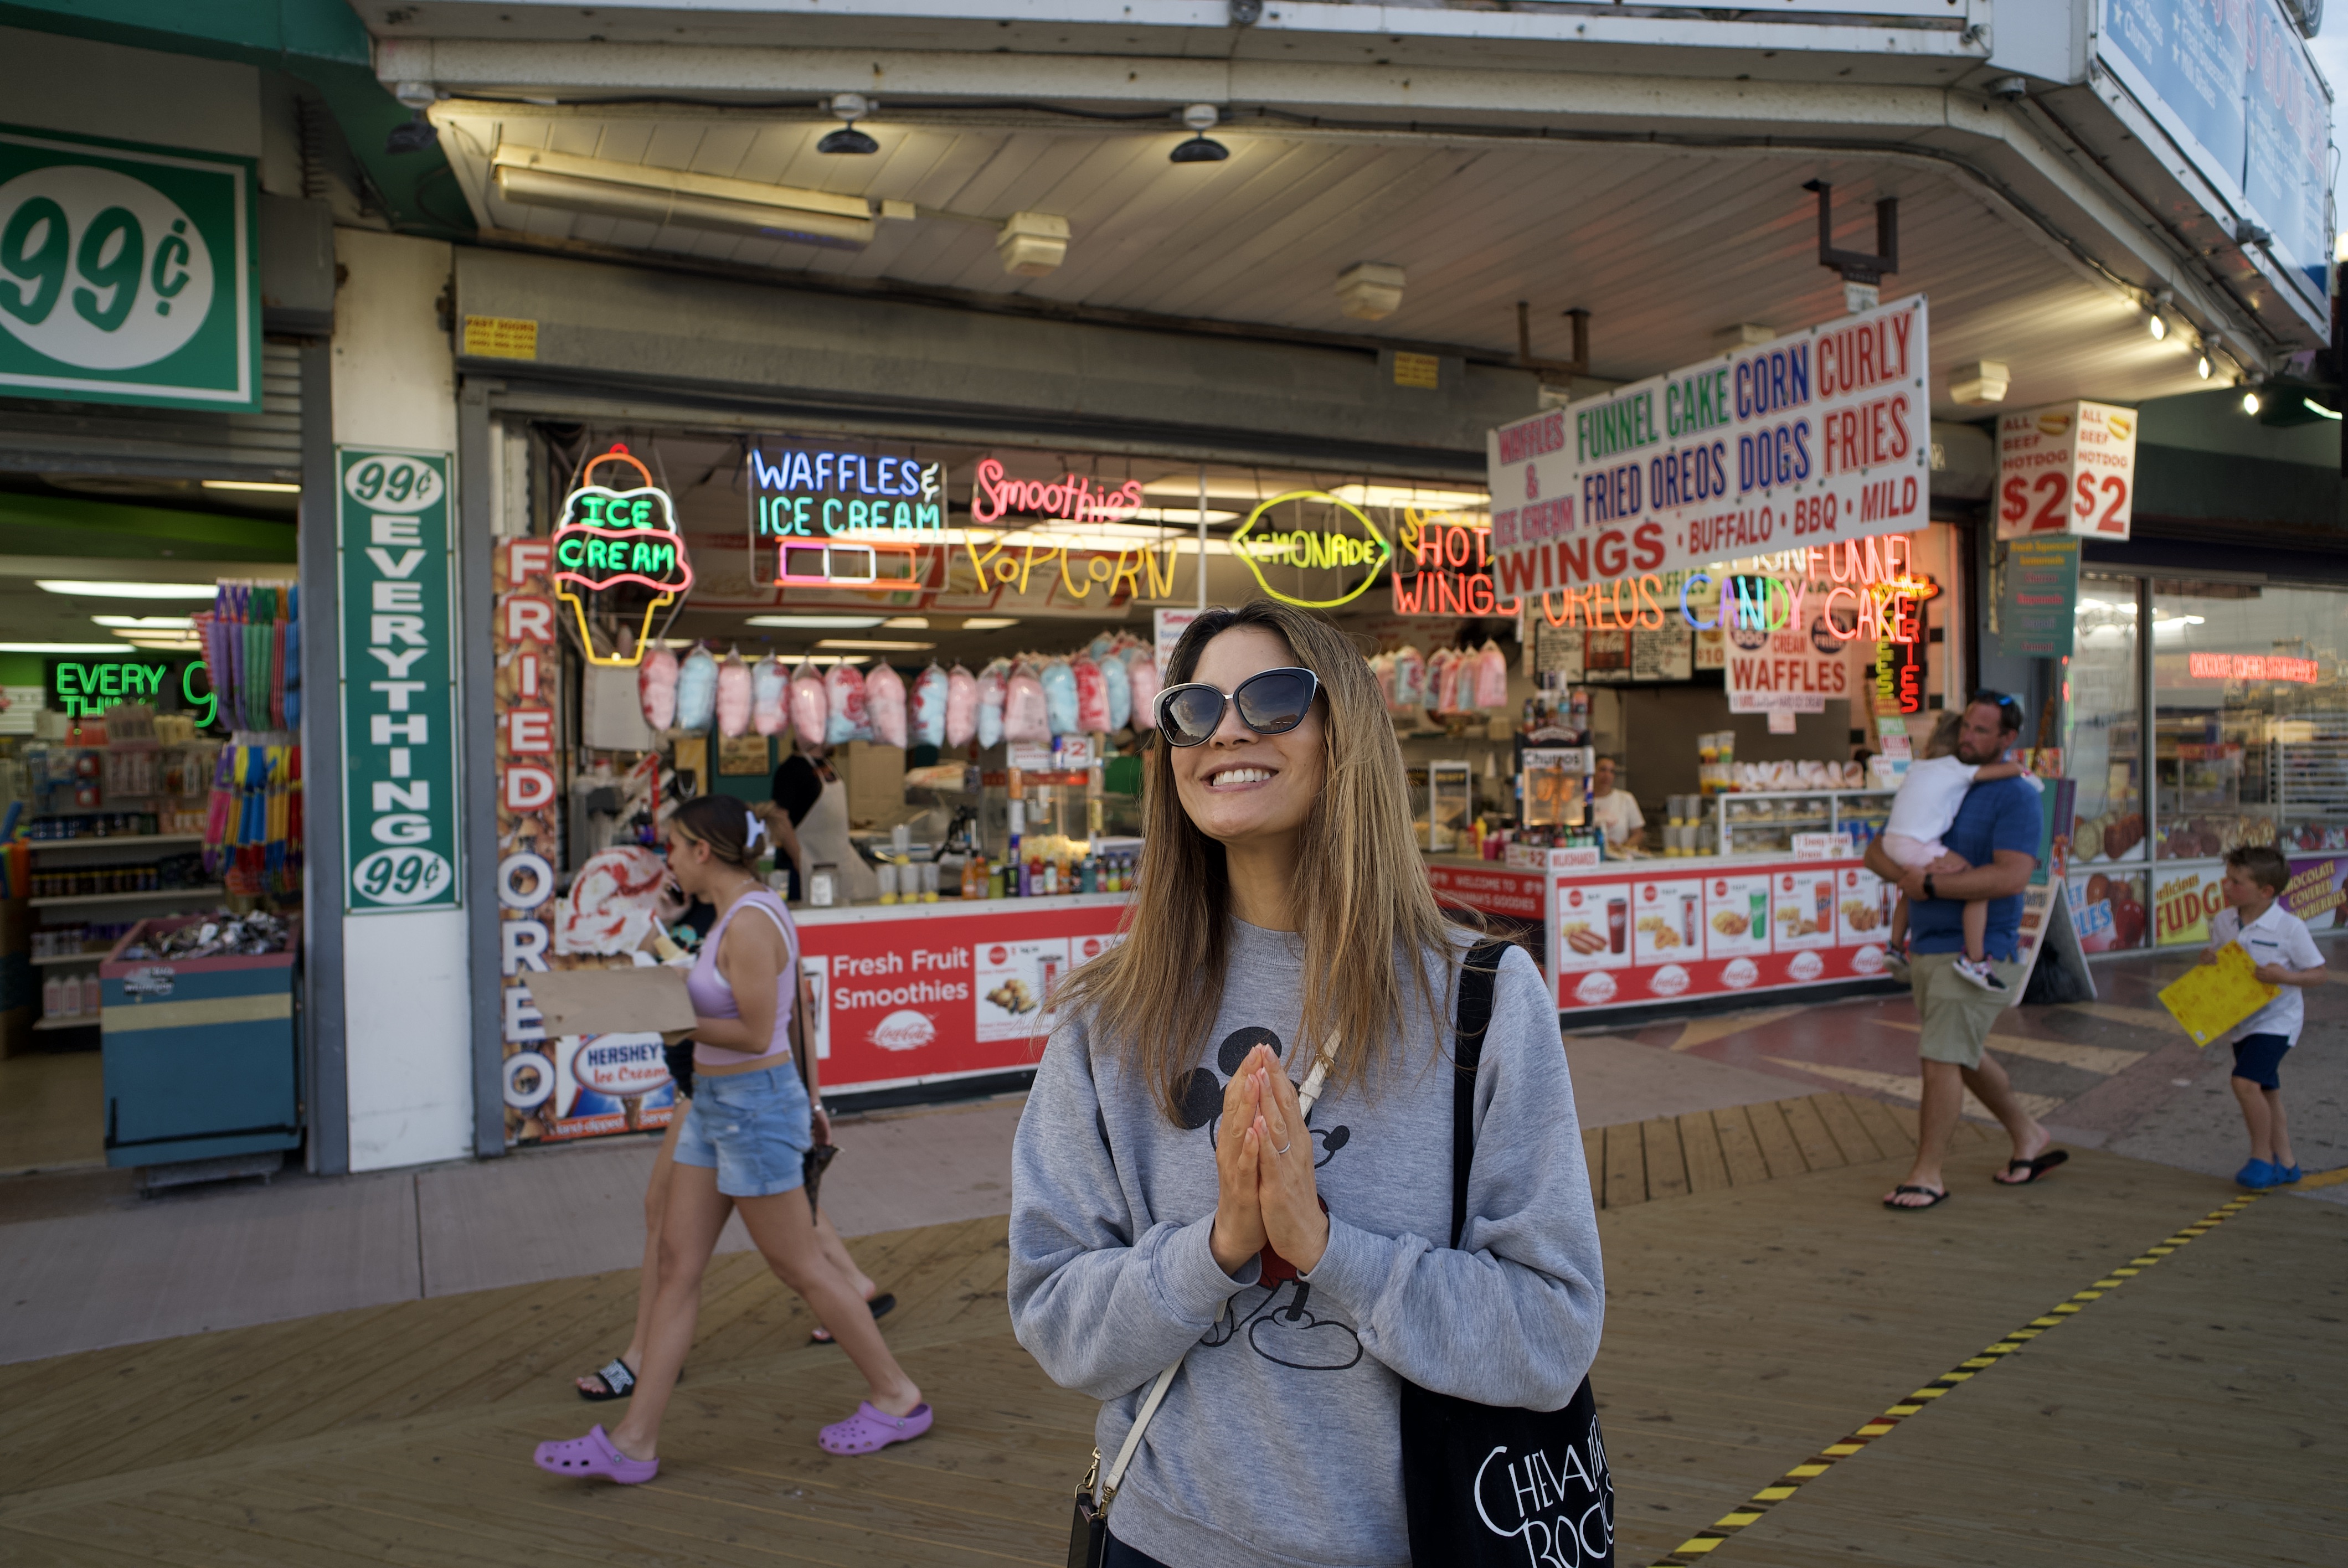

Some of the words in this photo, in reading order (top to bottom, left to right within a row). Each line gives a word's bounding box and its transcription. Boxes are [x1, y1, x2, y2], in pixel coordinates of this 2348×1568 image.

[1816, 308, 1914, 399] CURLY
[1735, 341, 1809, 421] CORN
[1577, 389, 1659, 463] FUNNEL
[1665, 365, 1732, 439] CAKE
[1822, 394, 1910, 476] FRIES
[2003, 417, 2031, 431] ALL
[2081, 408, 2102, 424] ALL
[1498, 412, 1565, 465] WAFFLES
[1739, 418, 1811, 494] DOGS
[2002, 433, 2041, 451] BEEF
[2080, 428, 2109, 445] BEEF
[753, 449, 920, 497] WAFFLES
[2002, 448, 2068, 470] HOTDOG
[2077, 450, 2128, 469] HOTDOG
[356, 462, 435, 503] 99¢
[972, 458, 1142, 524] Smoothies
[1583, 463, 1642, 526] FRIED
[1650, 439, 1726, 511] OREOS
[2002, 471, 2068, 532] $2
[2074, 468, 2127, 533] $2
[581, 497, 655, 530] ICE
[759, 495, 812, 536] ICE
[822, 496, 940, 539] CREAM
[1497, 522, 1666, 596] WINGS
[1688, 505, 1772, 554] BUFFALO
[1793, 492, 1838, 537] BBQ
[1860, 474, 1919, 524] MILD
[558, 538, 674, 572] CREAM
[1242, 531, 1377, 570] LEMONADE
[1417, 524, 1492, 568] HOT
[1807, 534, 1925, 591] FUNNEL
[1679, 574, 1808, 631] CANDY
[1824, 586, 1913, 643] CAKE
[1773, 635, 1806, 654] CREAM
[56, 662, 167, 695] EVERY
[364, 515, 432, 845] EVERYTHING
[507, 542, 554, 812] FRIED
[1732, 658, 1846, 692] WAFFLES
[363, 854, 441, 896] 99¢
[497, 851, 555, 1109] OREO
[832, 950, 904, 978] Fresh
[911, 946, 969, 973] Fruit
[834, 979, 969, 1011] Smoothies
[593, 1067, 613, 1084] Ice
[618, 1065, 668, 1082] Cream
